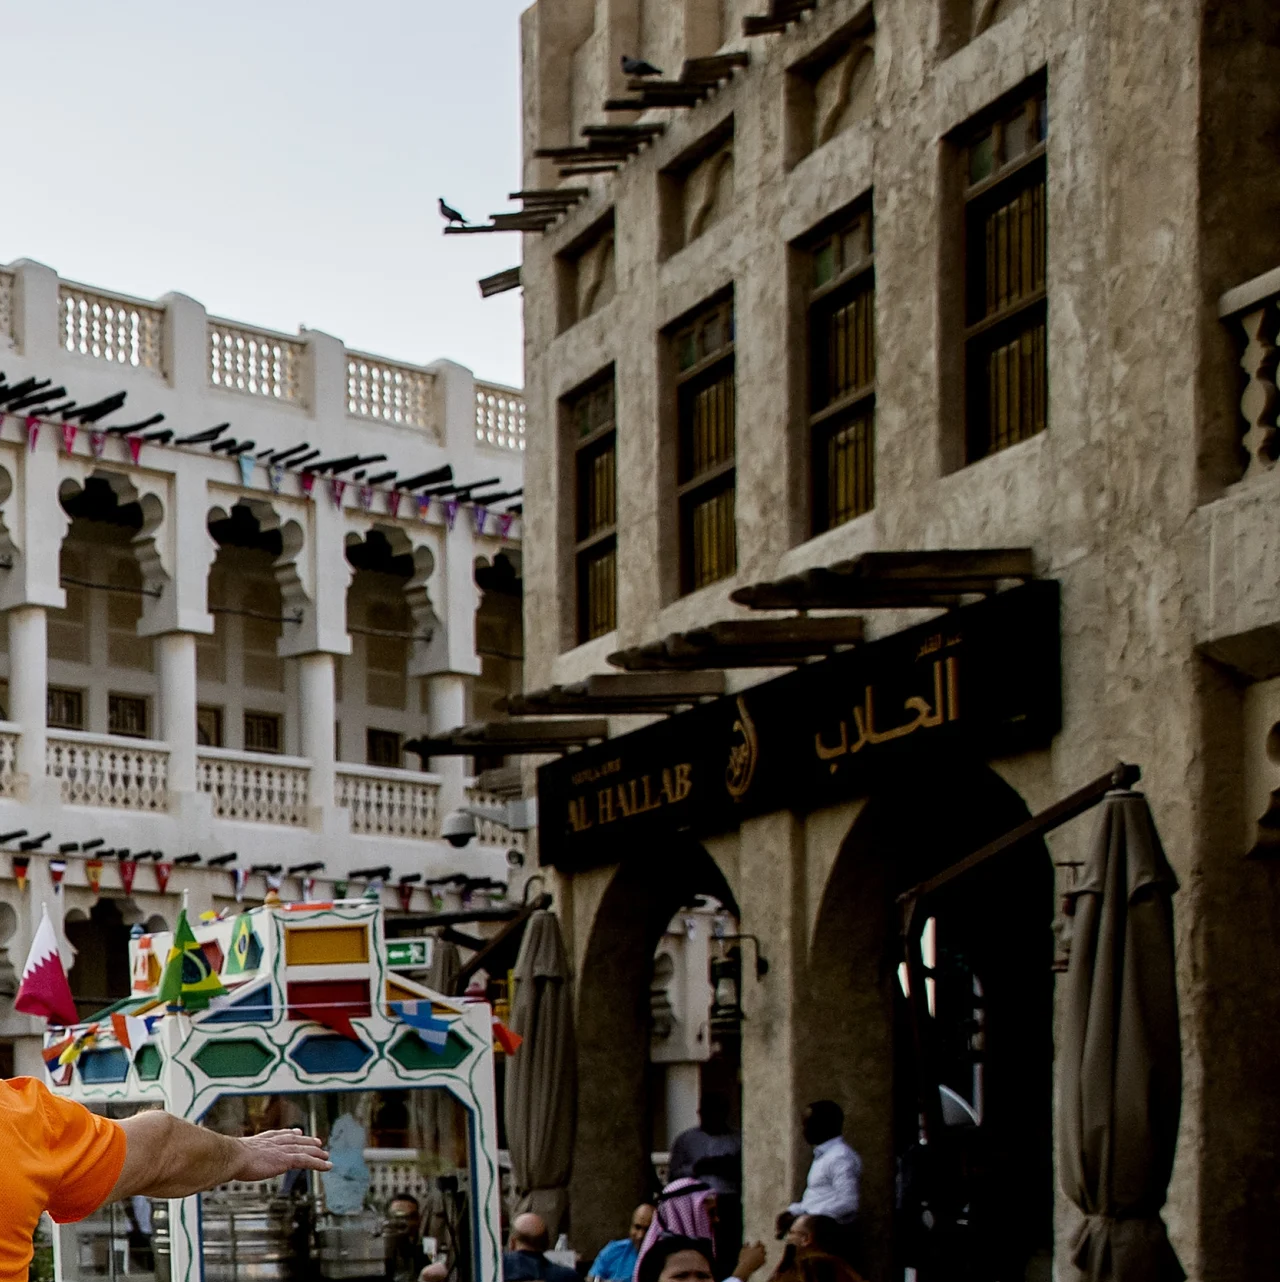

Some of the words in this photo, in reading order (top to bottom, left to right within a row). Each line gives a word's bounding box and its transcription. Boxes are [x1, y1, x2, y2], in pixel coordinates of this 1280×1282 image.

[814, 656, 960, 774] الحلاب
[567, 795, 595, 833] AL
[596, 761, 694, 825] HALLAB
